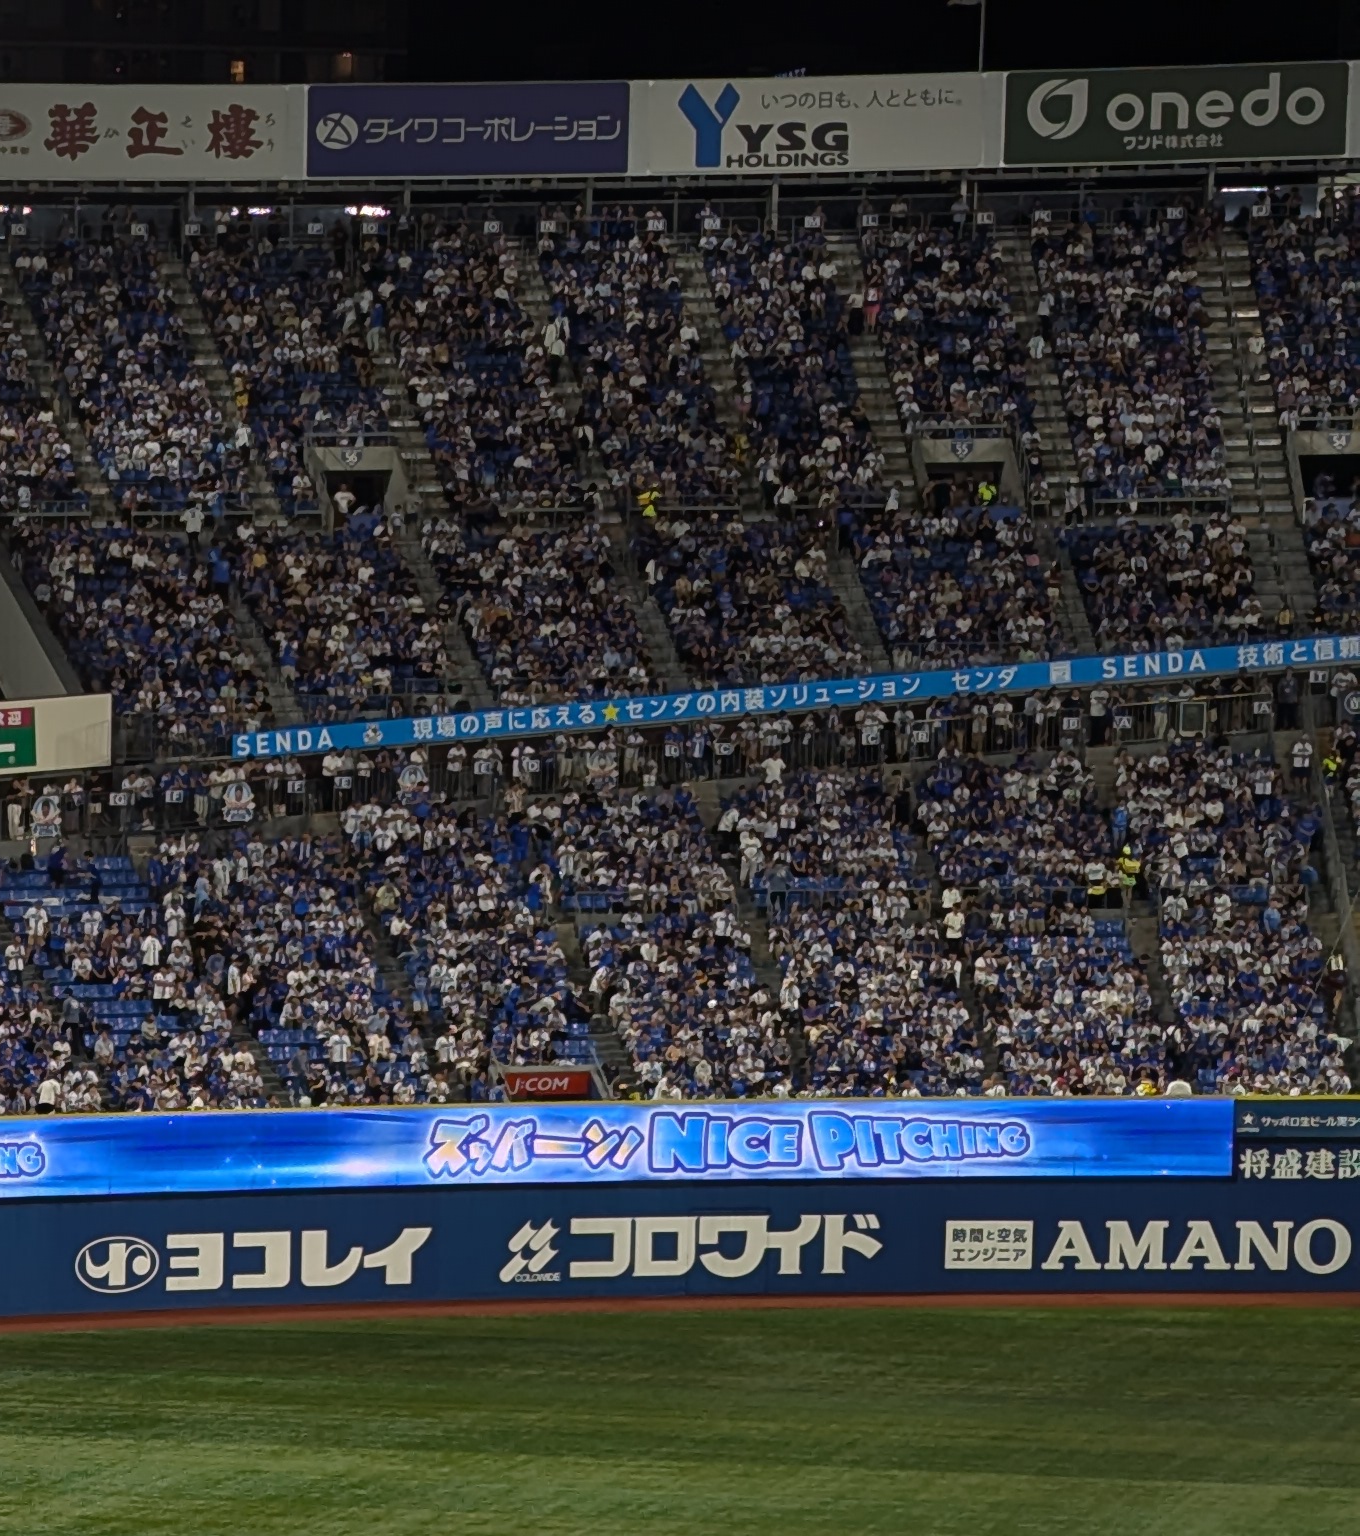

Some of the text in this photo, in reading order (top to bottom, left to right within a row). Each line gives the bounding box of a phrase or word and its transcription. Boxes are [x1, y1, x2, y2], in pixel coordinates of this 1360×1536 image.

[760, 88, 963, 110] いつの日も、人とともに。
[1105, 72, 1326, 132] onedo
[362, 114, 622, 145] ダイワコーポレーション
[736, 121, 850, 154] YSG
[1122, 131, 1225, 151] ワンド株式会社
[726, 151, 850, 169] HOLDINGS
[950, 665, 1018, 692] センダ
[1101, 652, 1207, 678] SENDA
[412, 703, 596, 740] 現場の声に応える
[235, 731, 334, 756] SENDA
[648, 1109, 1030, 1172] NICE PITCHING
[1238, 1147, 1360, 1180] 将盛建設
[568, 1213, 884, 1279] コロワイド
[952, 1227, 1028, 1244] 時間と空気
[1040, 1218, 1353, 1275] AMANO
[164, 1226, 434, 1292] ヨコレイ
[951, 1247, 1027, 1262] エンジニア
